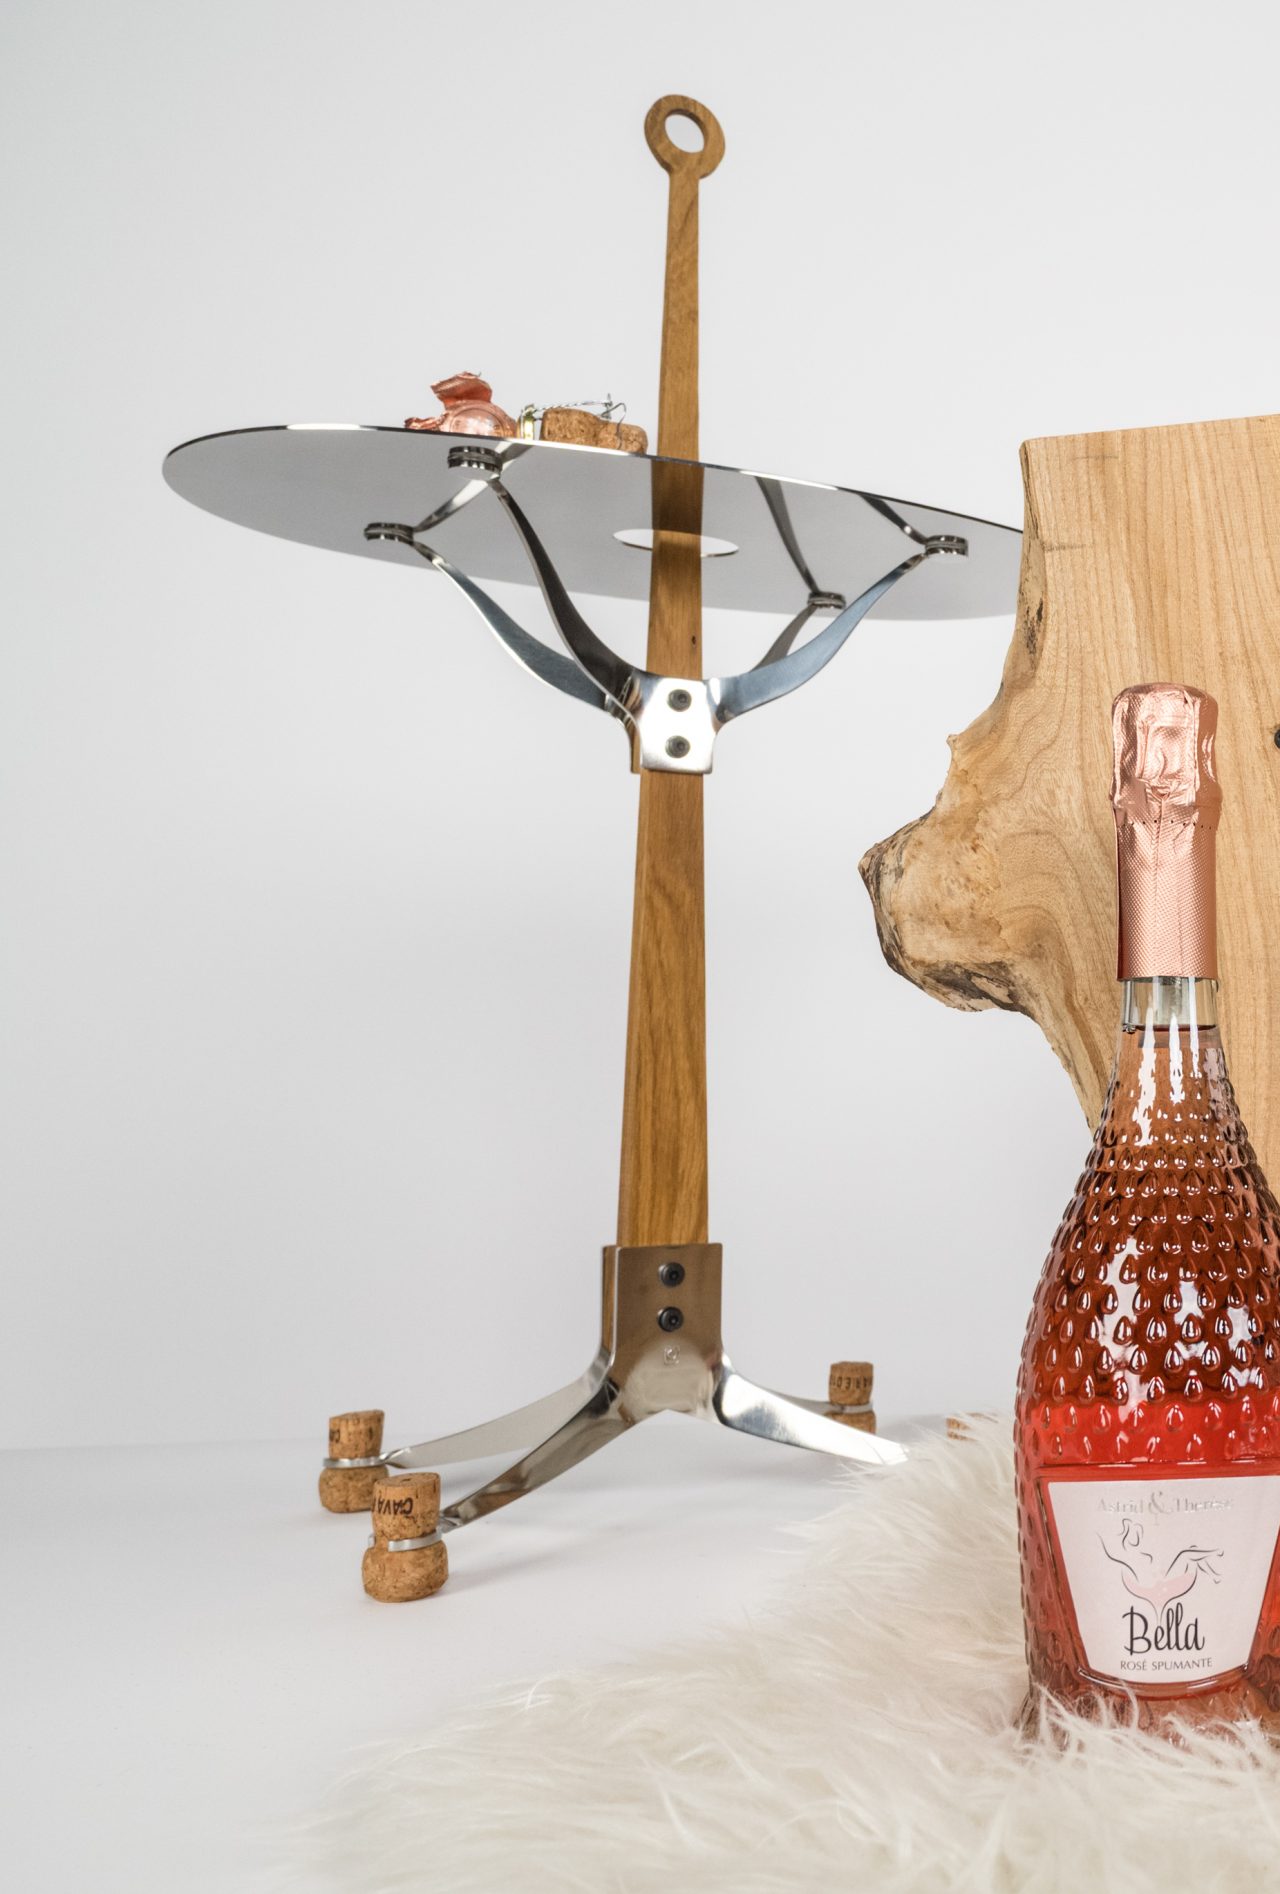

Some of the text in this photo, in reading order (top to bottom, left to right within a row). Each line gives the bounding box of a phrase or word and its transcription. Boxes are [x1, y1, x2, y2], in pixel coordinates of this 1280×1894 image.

[1097, 1497, 1144, 1514] Astrid
[1148, 1491, 1174, 1515] &
[1122, 1602, 1205, 1656] Bella
[1120, 1657, 1212, 1671] ROSÉ SPUMANTE
